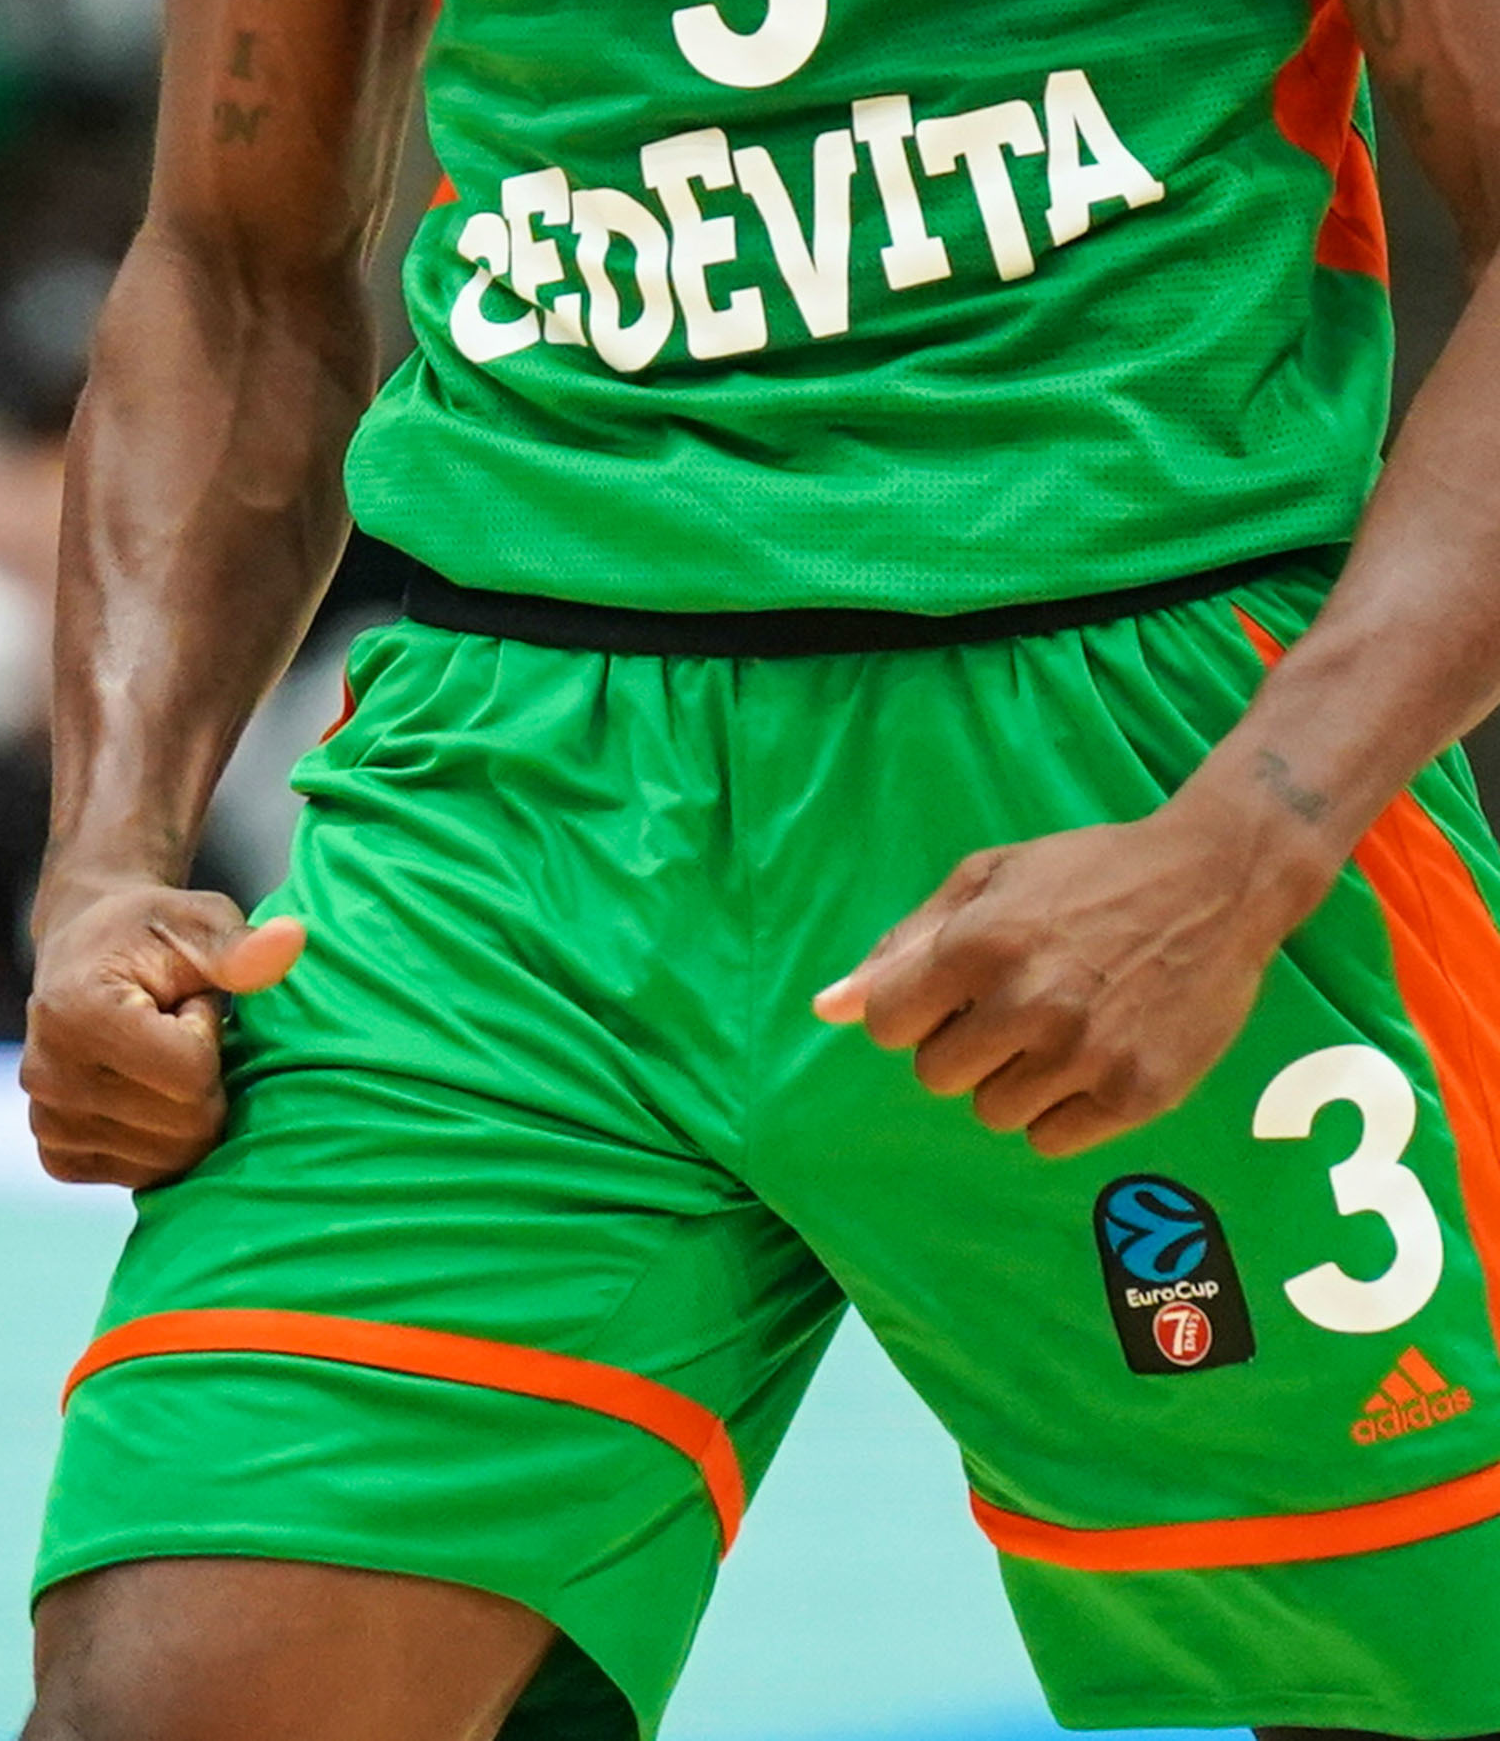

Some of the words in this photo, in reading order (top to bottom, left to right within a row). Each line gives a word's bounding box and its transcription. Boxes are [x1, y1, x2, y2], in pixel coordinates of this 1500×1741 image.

[1252, 1044, 1443, 1334] 3
[1125, 1280, 1220, 1308] EuroCup
[1162, 1310, 1192, 1357] 7
[1350, 1384, 1471, 1446] adidas
